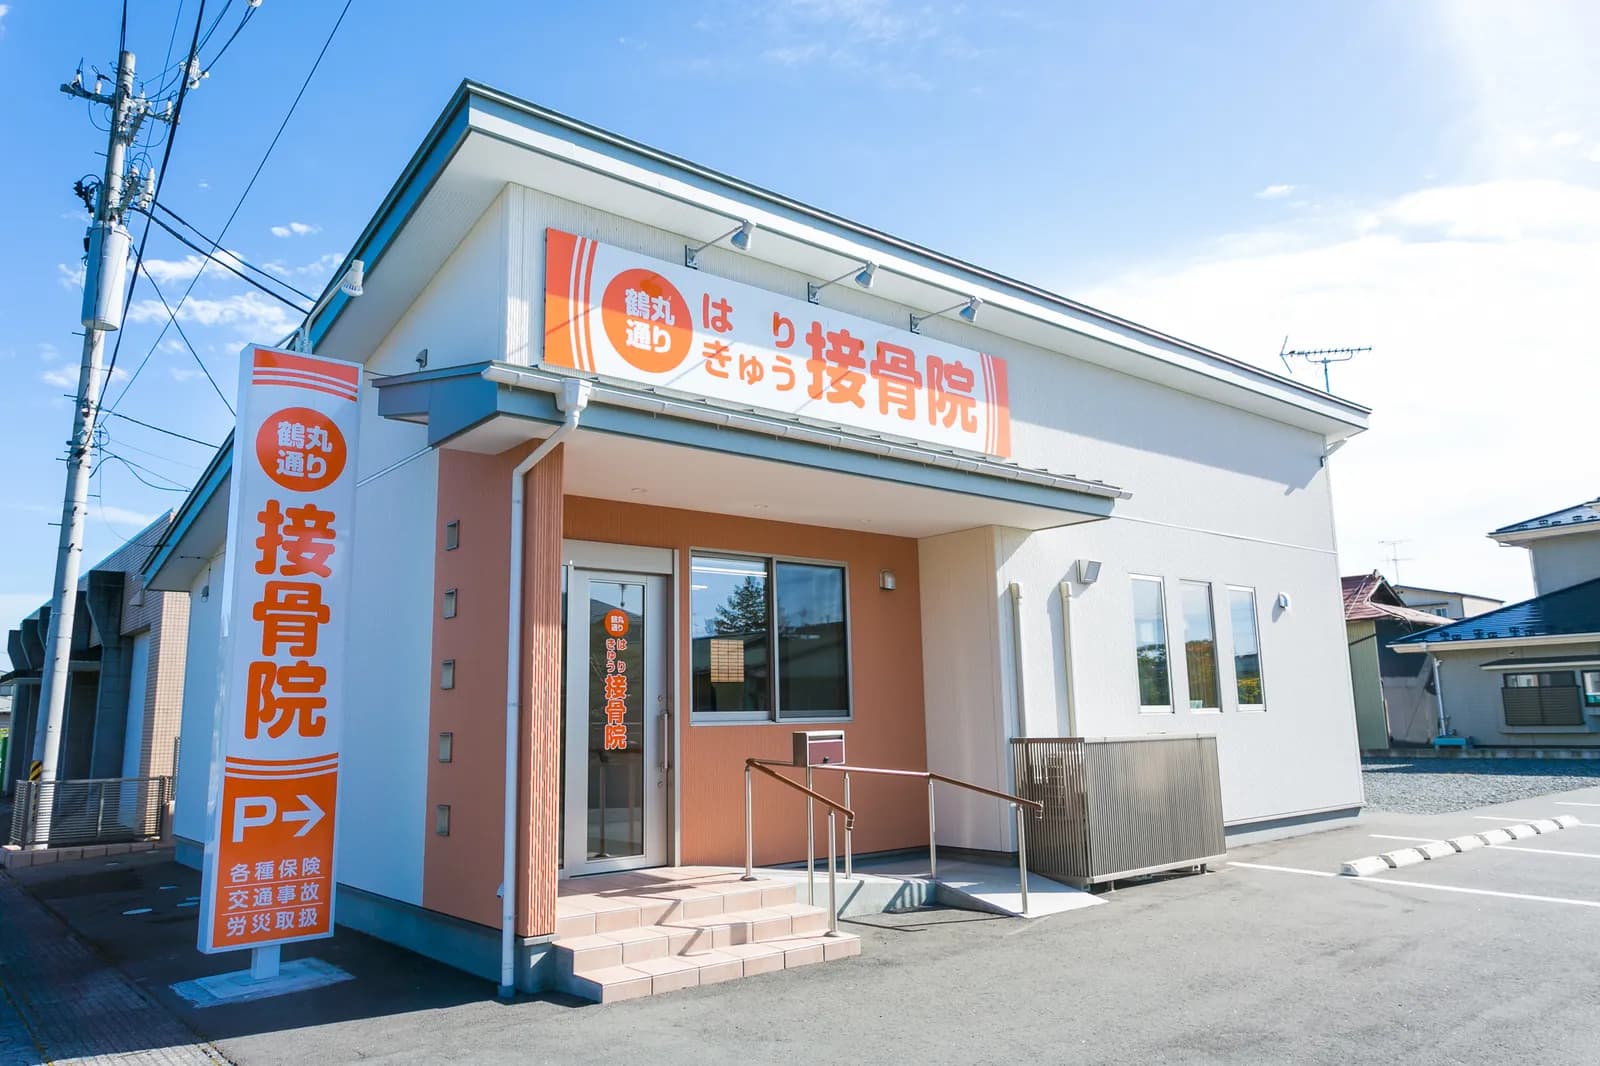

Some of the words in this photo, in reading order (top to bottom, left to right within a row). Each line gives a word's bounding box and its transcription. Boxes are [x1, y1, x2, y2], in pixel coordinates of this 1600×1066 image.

[625, 287, 676, 325] 鶴丸
[625, 319, 672, 353] 通り
[702, 340, 796, 391] きゅう
[805, 320, 978, 434] 接骨院
[277, 421, 332, 453] 鶴丸
[276, 450, 327, 479] 通り
[244, 499, 336, 740] 接骨院
[606, 638, 616, 673] きゅう
[604, 674, 627, 750] 接骨院
[232, 796, 277, 842] P
[229, 857, 321, 884] 各種保険
[228, 882, 319, 911] 交通事故
[226, 908, 317, 937] 労災取扱
